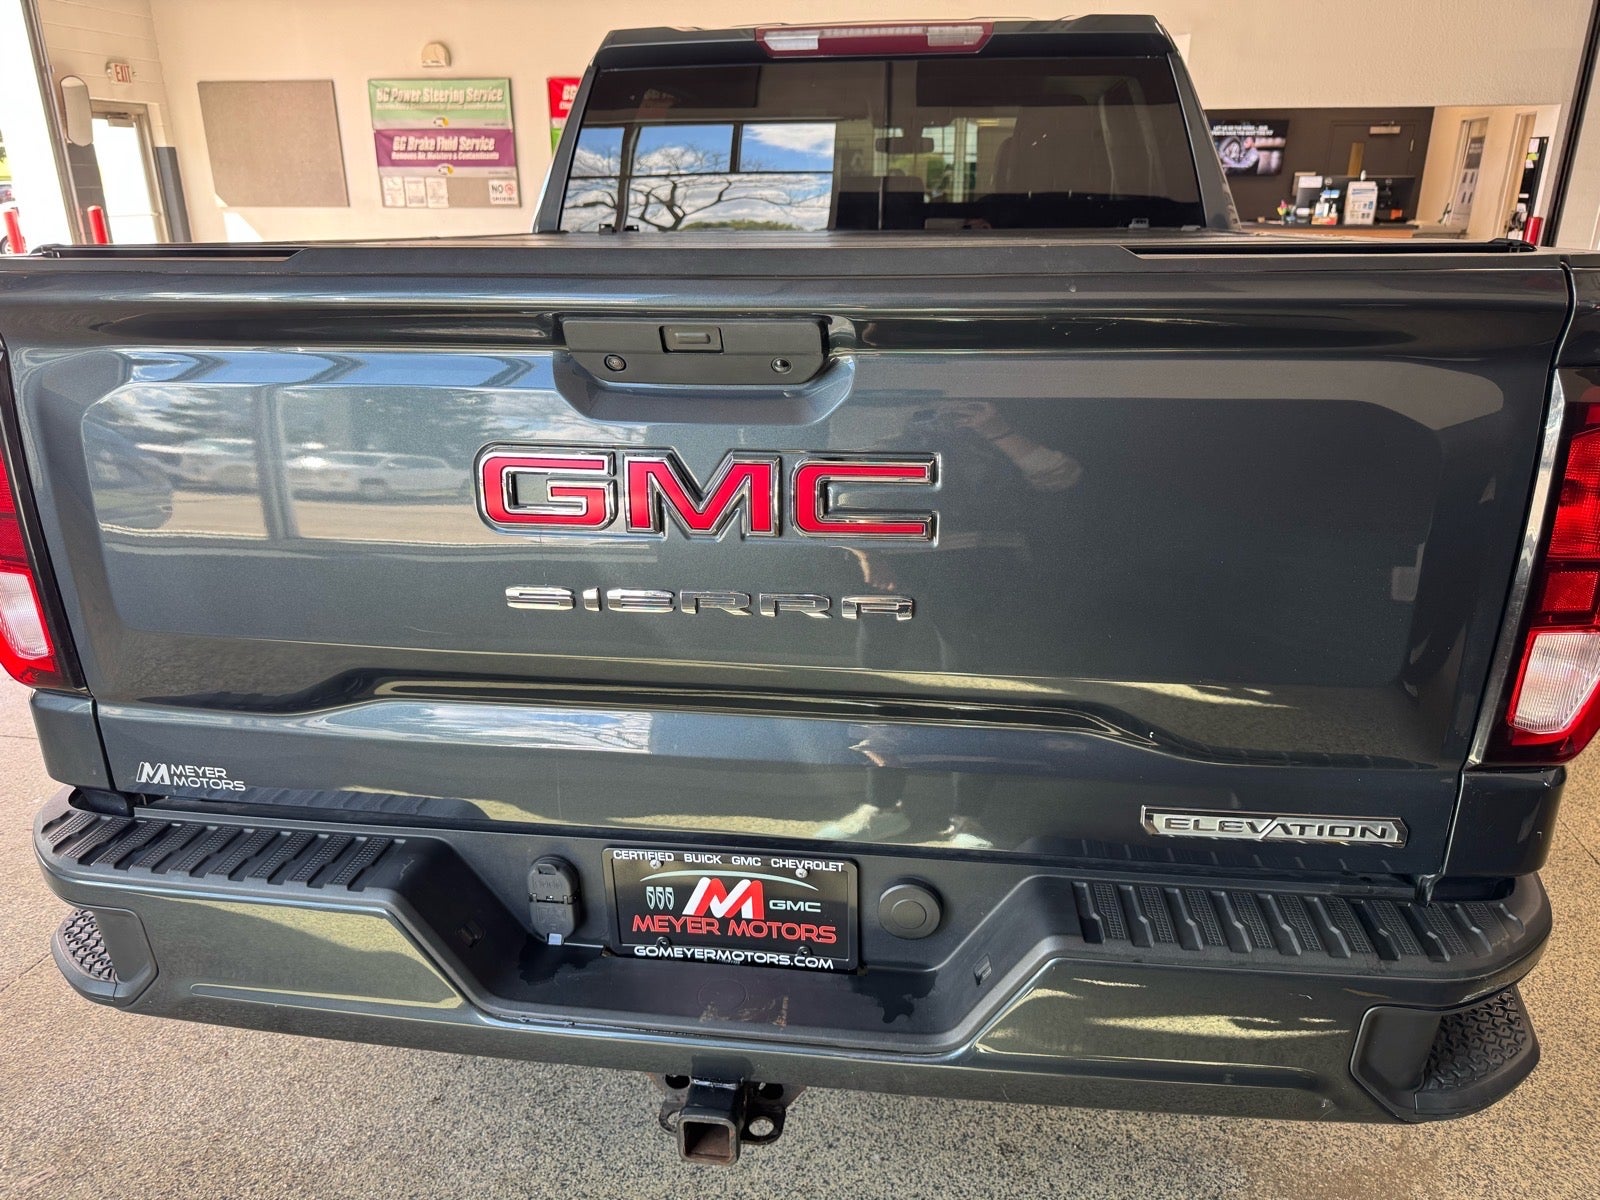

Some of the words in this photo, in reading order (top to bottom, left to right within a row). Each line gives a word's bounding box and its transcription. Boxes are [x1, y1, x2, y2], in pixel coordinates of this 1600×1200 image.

[114, 64, 132, 83] EXIT
[391, 87, 421, 103] Power
[422, 86, 465, 105] Steering
[466, 86, 504, 103] Service
[407, 136, 436, 151] Brake
[436, 136, 459, 151] Fluid
[459, 135, 495, 151] Service
[491, 184, 503, 194] NO
[476, 442, 941, 546] GMC
[505, 584, 914, 621] SIERRA
[170, 764, 228, 779] MEYER
[173, 776, 246, 791] MOTORS
[1164, 816, 1389, 840] ELEVATION
[613, 850, 674, 862] CERTIFIED
[684, 853, 722, 865] BUICK
[731, 855, 761, 867] GMC
[770, 858, 844, 873] CHEVROLET
[769, 899, 822, 913] GMC
[632, 914, 721, 936] MEYER
[728, 919, 837, 944] MOTORS
[633, 945, 835, 970] GOMEYERMOTORS.COM
